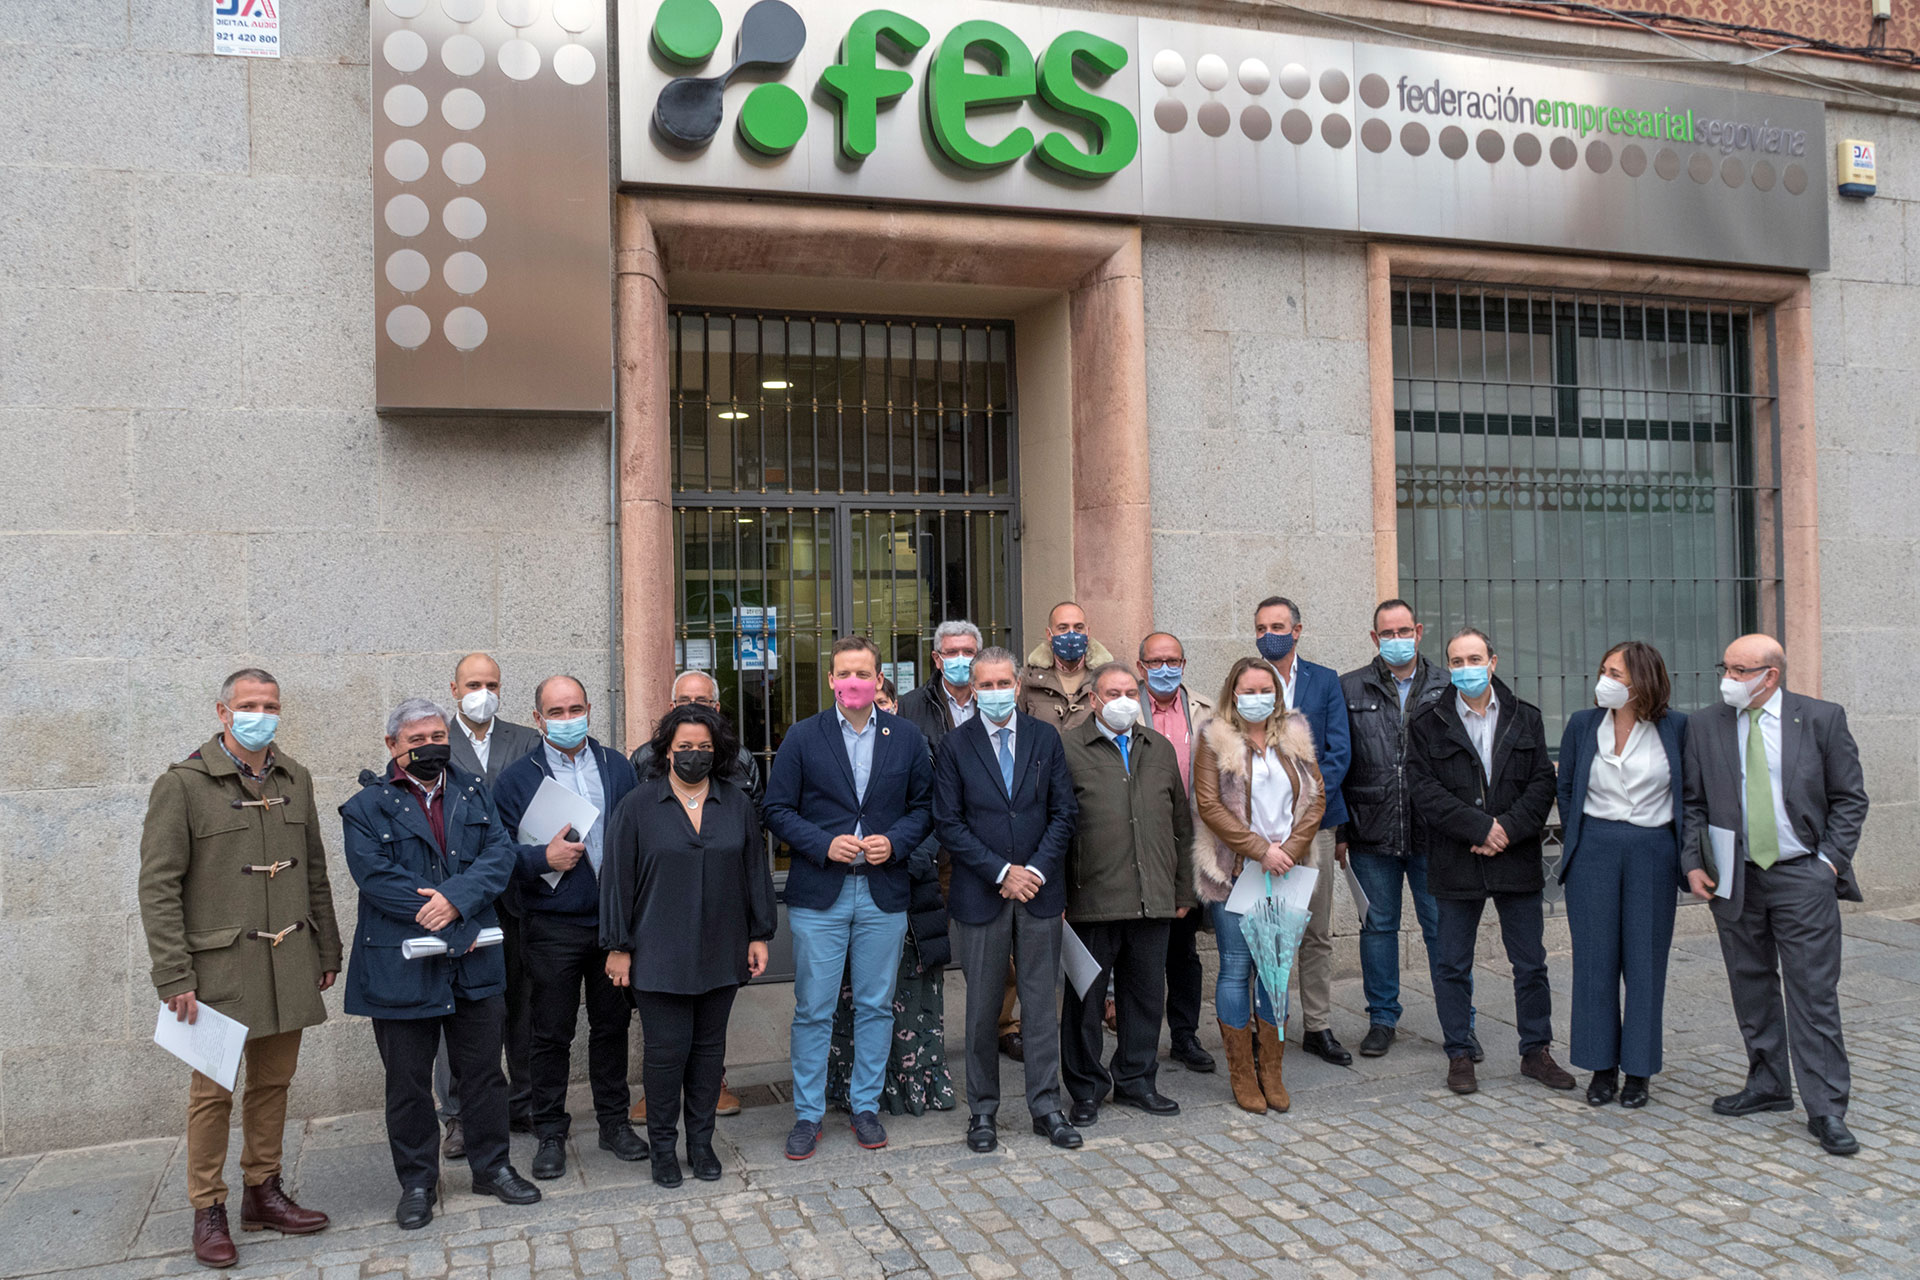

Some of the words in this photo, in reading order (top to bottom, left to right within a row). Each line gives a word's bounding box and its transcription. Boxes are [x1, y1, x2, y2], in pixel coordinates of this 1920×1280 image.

[216, 19, 248, 27] DIGITAL
[251, 21, 277, 29] AUDIO
[216, 32, 234, 41] 921
[238, 33, 256, 42] 420
[259, 34, 278, 43] 800
[819, 9, 1138, 179] fes
